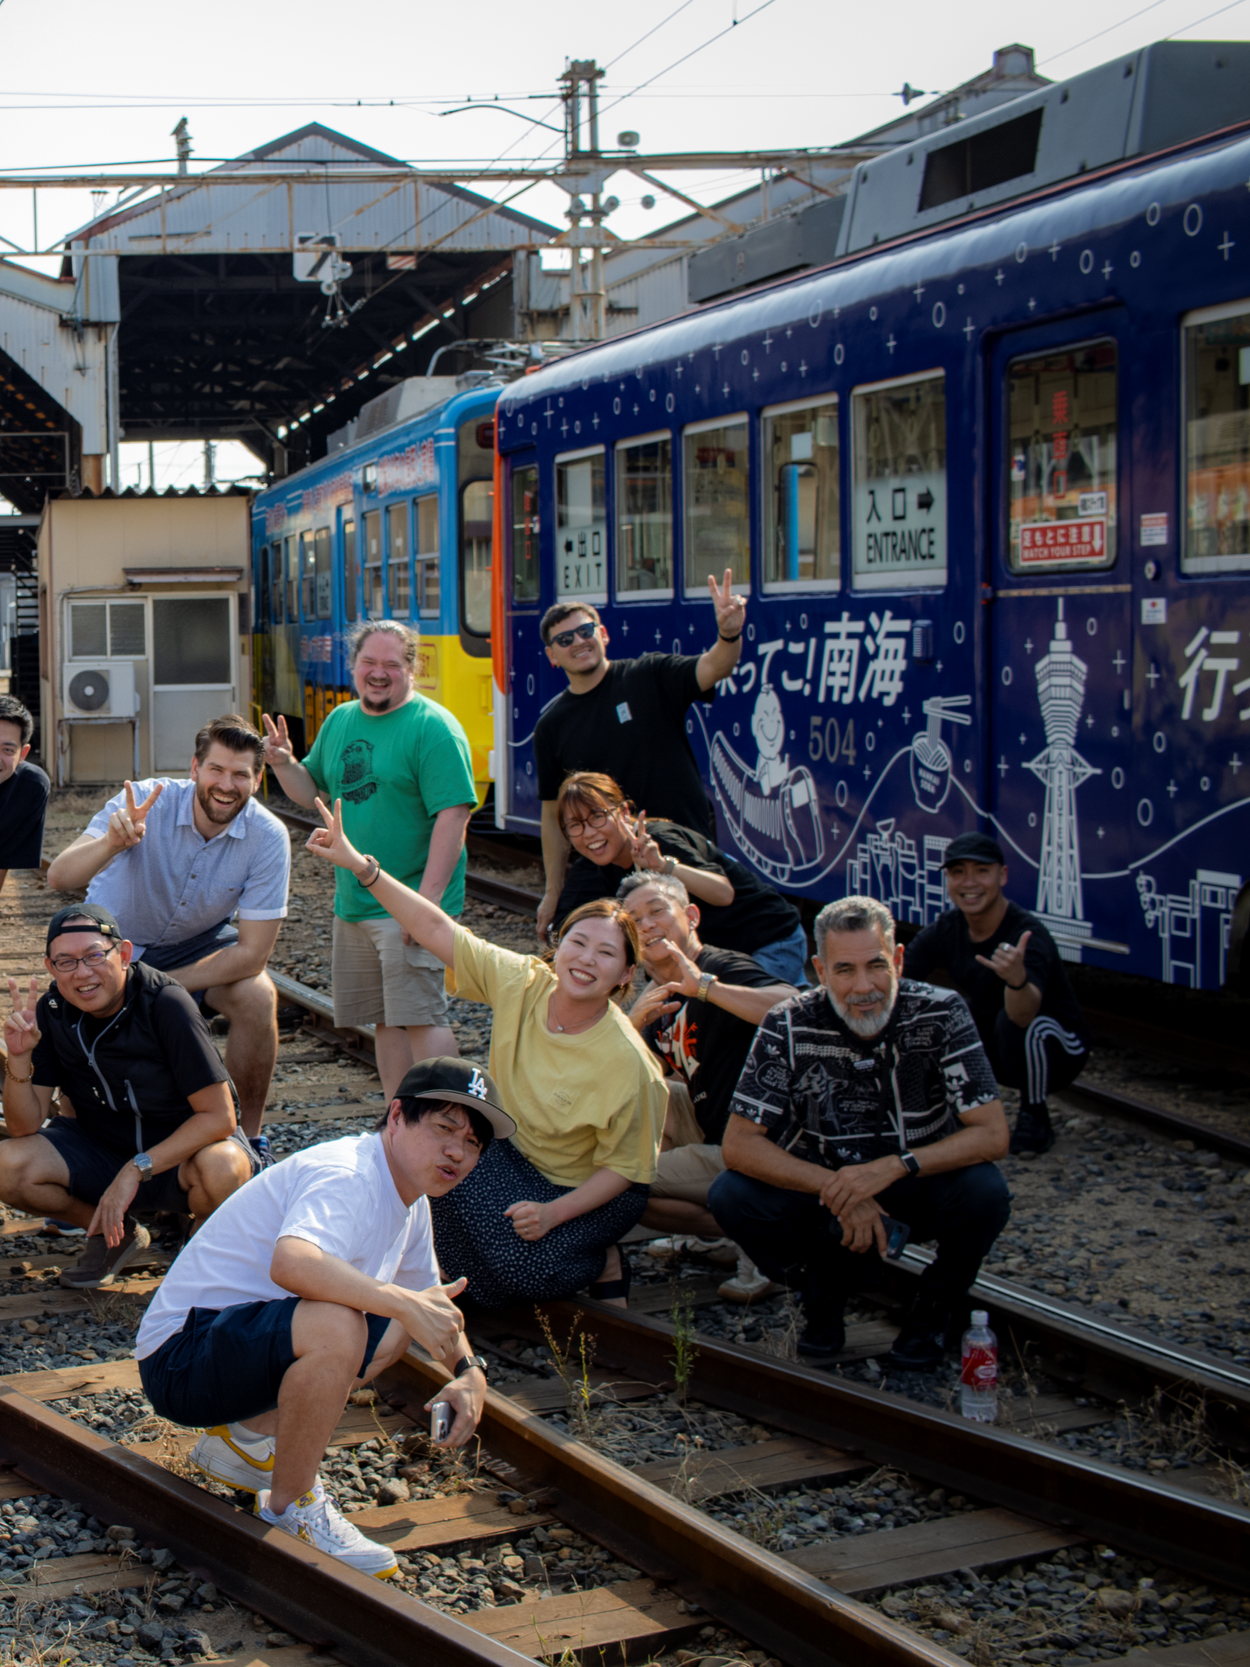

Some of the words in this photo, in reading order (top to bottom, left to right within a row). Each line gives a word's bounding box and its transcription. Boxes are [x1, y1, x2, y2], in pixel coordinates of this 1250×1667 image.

[298, 236, 336, 277] 7
[867, 487, 906, 523] 入口
[578, 530, 601, 558] 出口
[867, 527, 935, 564] ENTRANCE
[1023, 547, 1049, 560] WATCH
[1050, 546, 1071, 557] YOUR
[1073, 544, 1091, 556] STEP
[564, 562, 602, 589] EXIT
[809, 716, 856, 765] 504
[1056, 770, 1064, 909] TSUTENKAKU
[468, 1067, 487, 1100] LA
